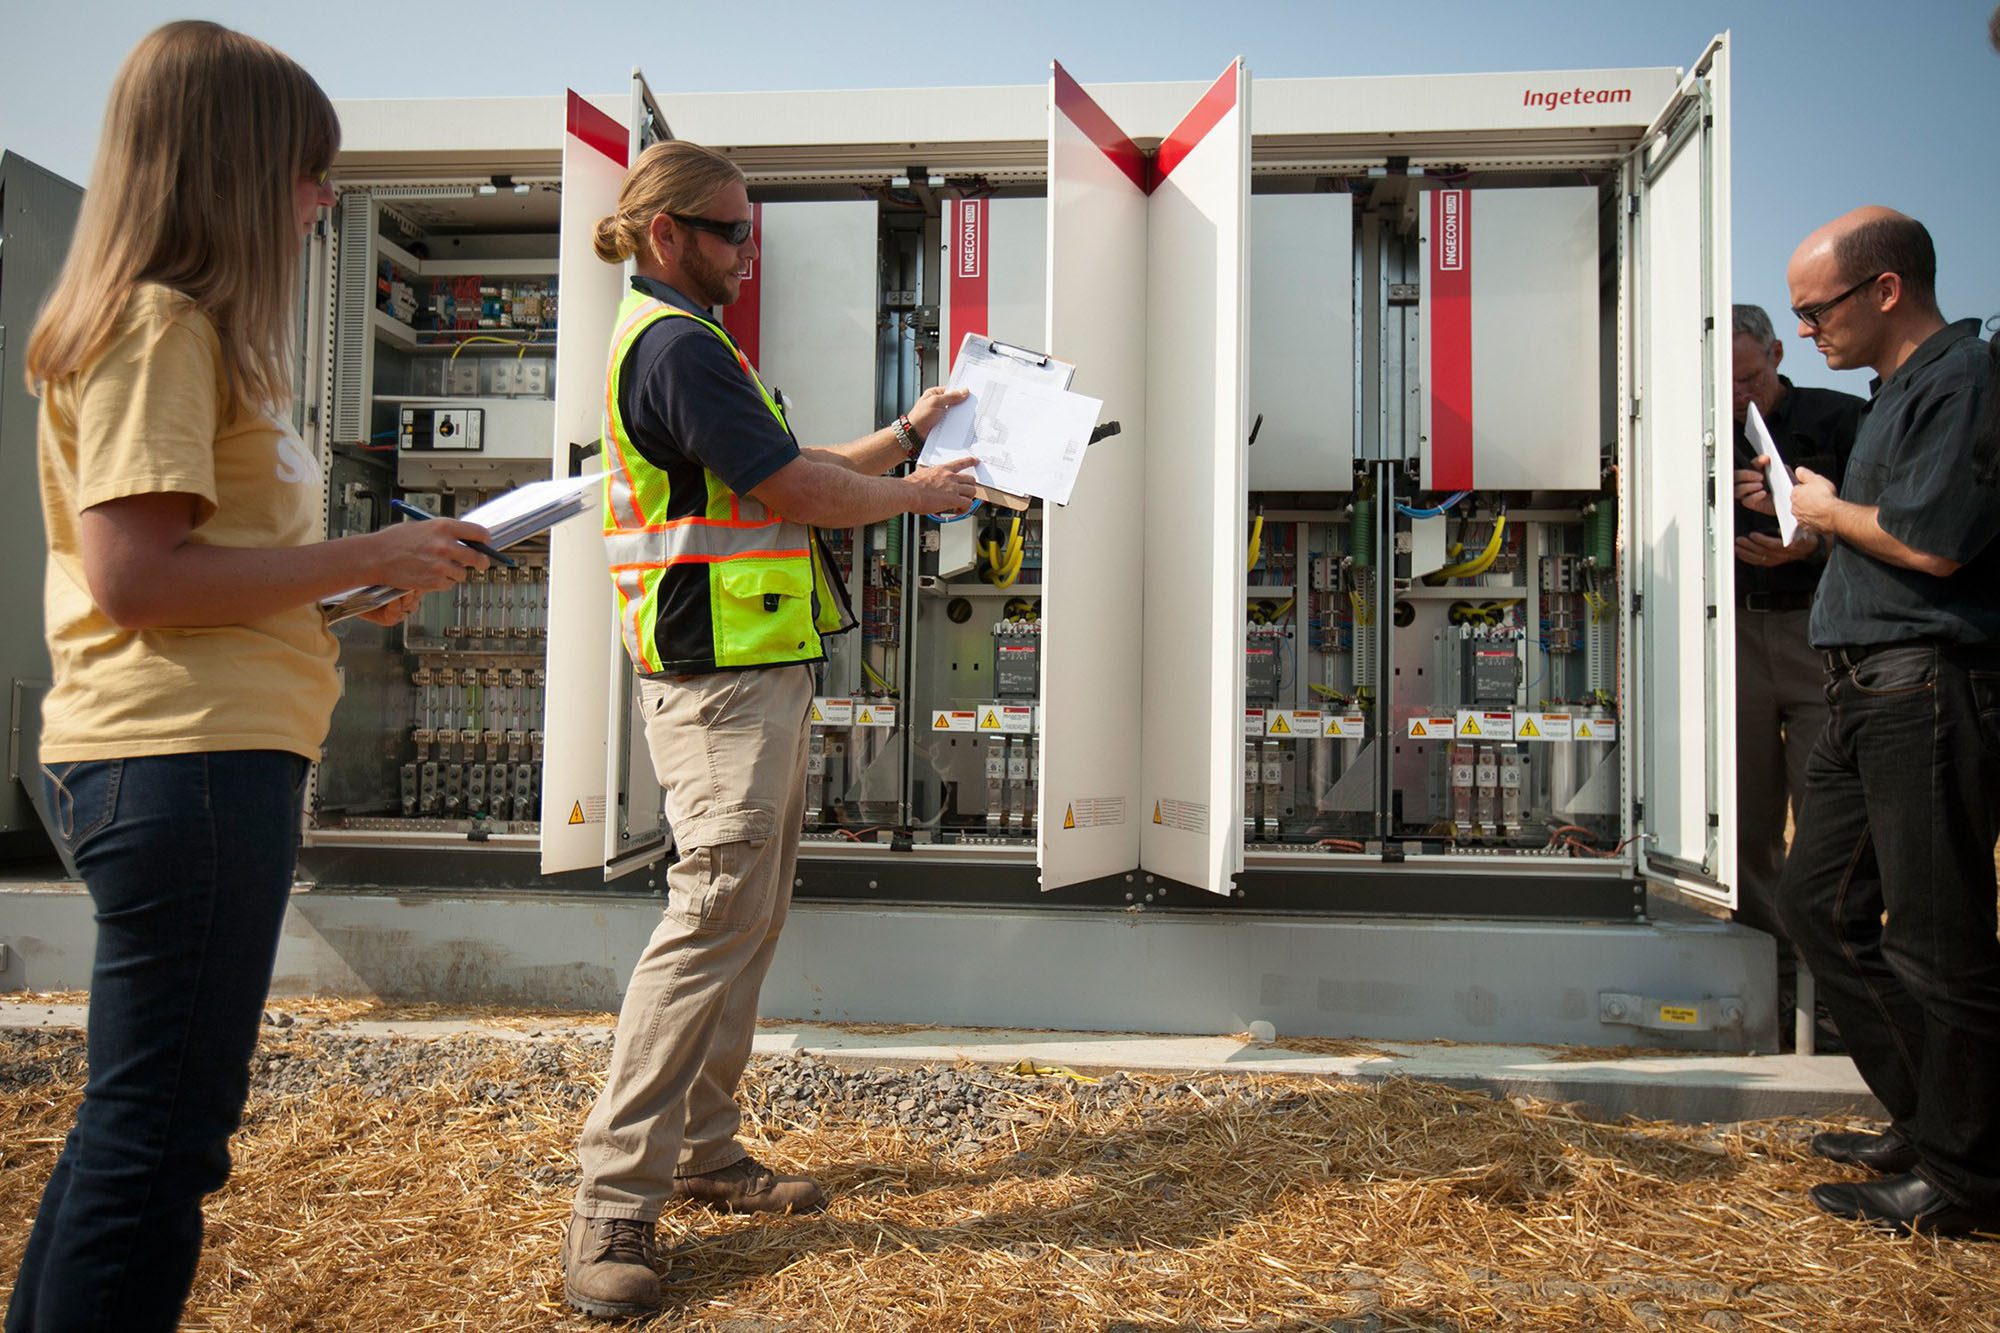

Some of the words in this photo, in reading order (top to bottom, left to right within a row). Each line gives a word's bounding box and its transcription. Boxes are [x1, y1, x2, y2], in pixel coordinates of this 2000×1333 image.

[1523, 87, 1632, 111] Ingeteam
[966, 206, 974, 222] SUN
[1447, 195, 1456, 212] SUN
[964, 224, 975, 273] INGECON
[1446, 214, 1457, 265] INGECON
